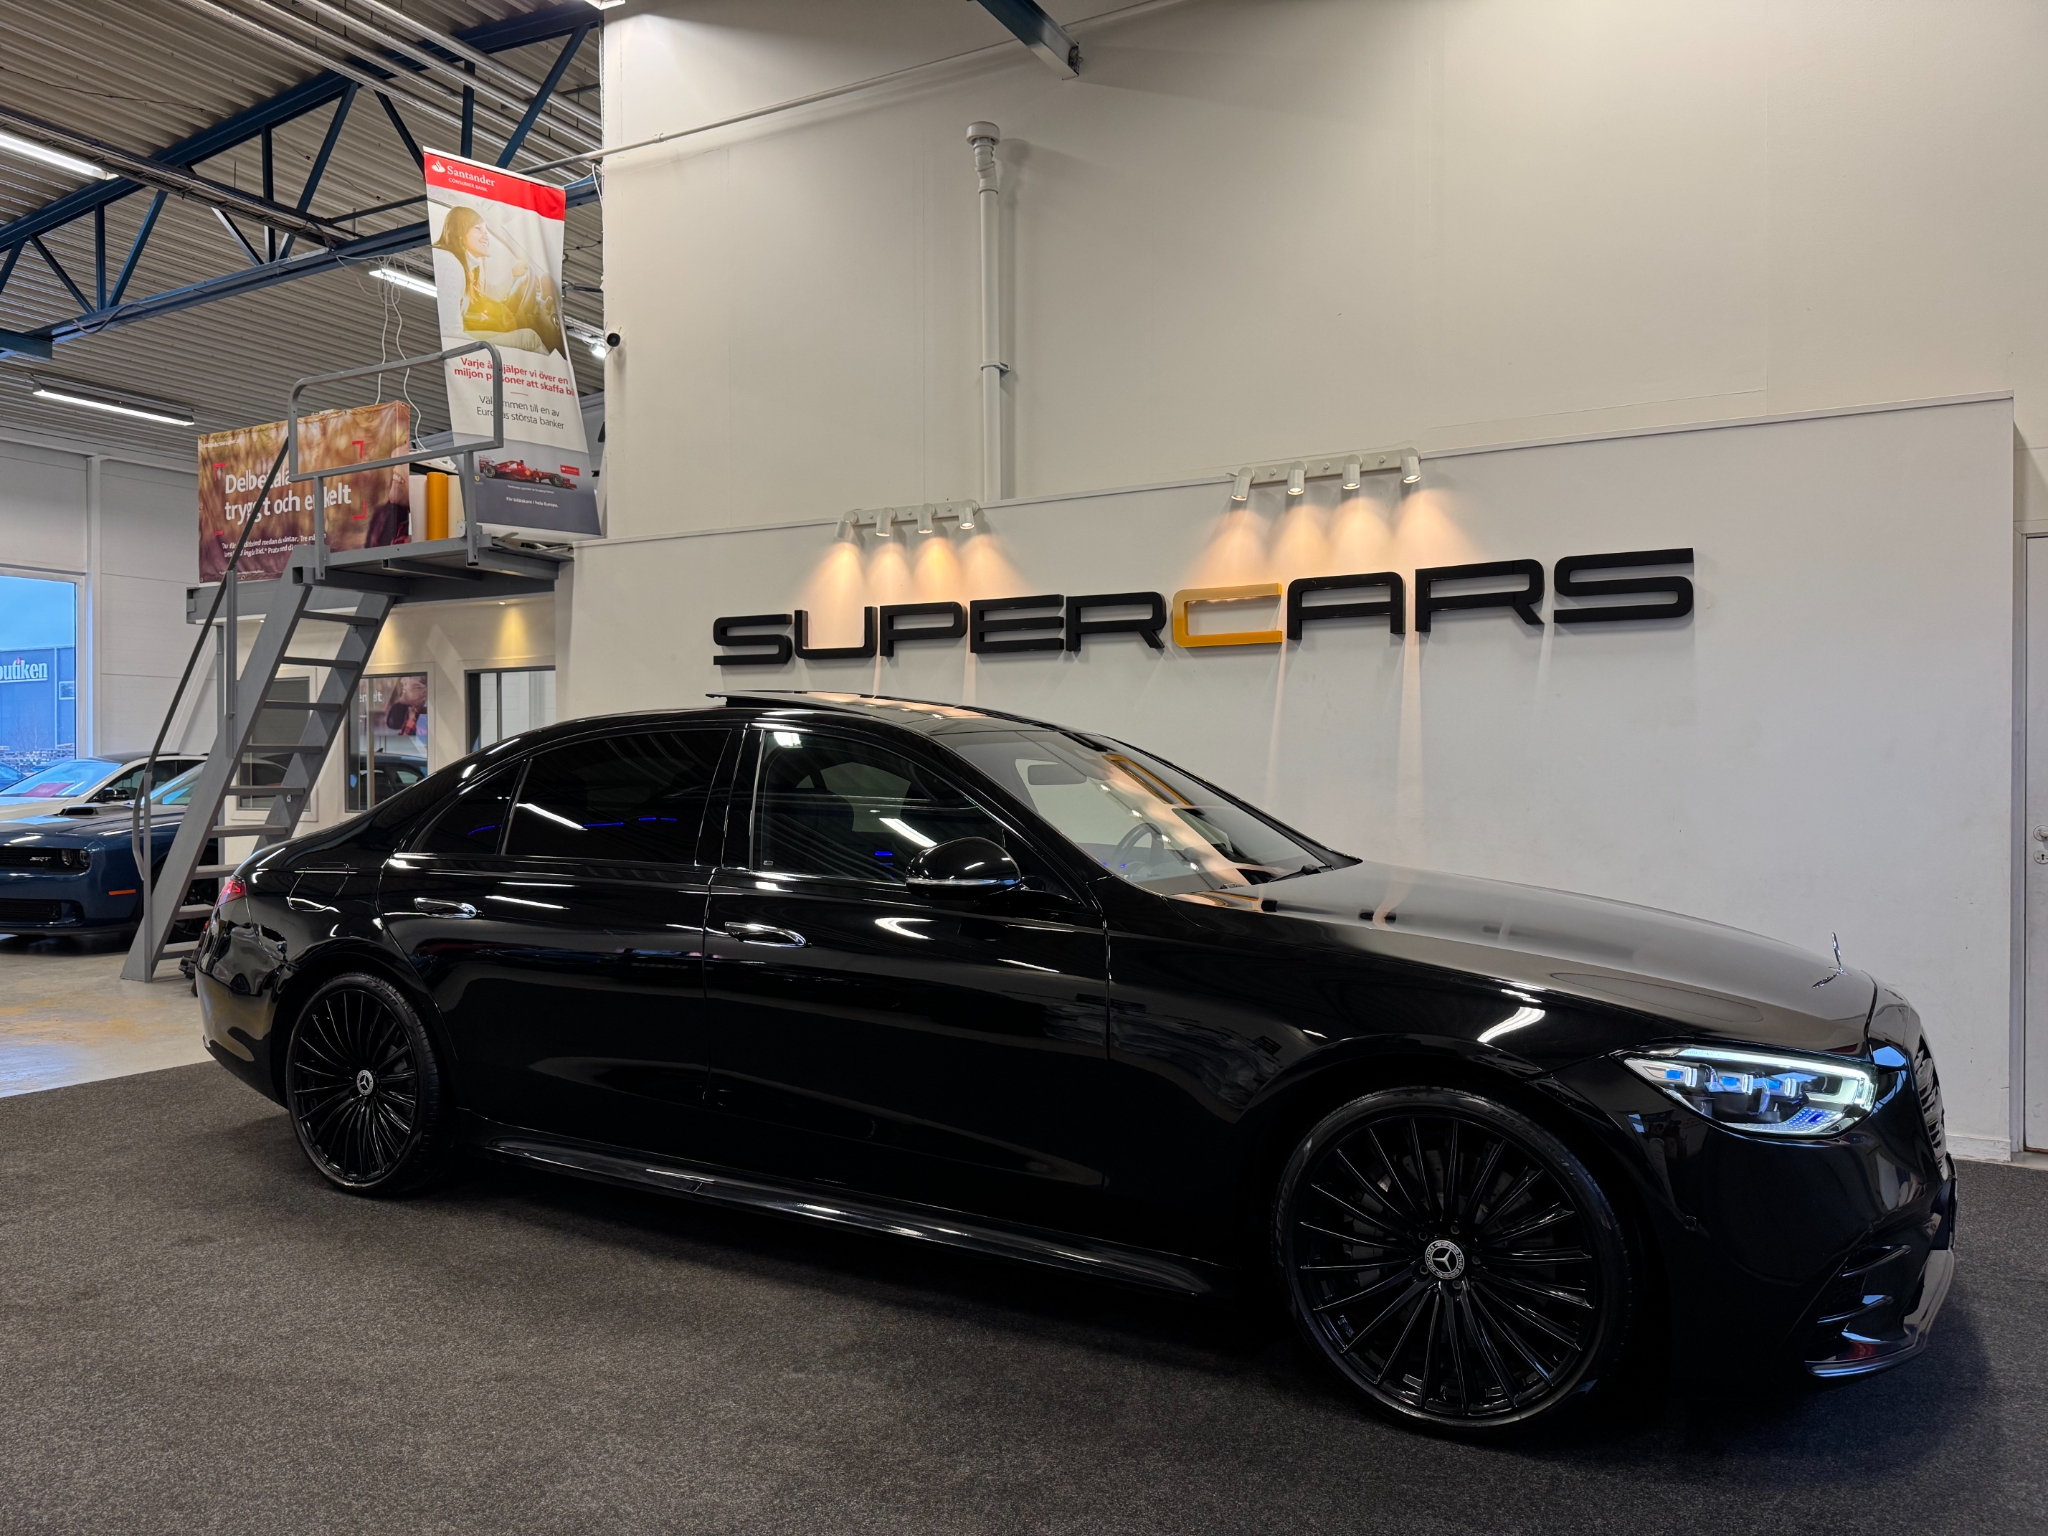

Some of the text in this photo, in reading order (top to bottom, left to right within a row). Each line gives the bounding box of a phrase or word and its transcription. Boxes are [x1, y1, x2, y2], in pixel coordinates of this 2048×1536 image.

[447, 165, 495, 186] Santander
[448, 178, 488, 192] CONSUMER BANK
[454, 368, 575, 396] miljon poner att skaffa bi
[460, 357, 569, 385] Varje å jälper vi över en
[477, 407, 564, 429] Euroas största banker
[478, 395, 528, 410] Välmmen
[529, 403, 539, 413] till
[225, 464, 291, 494] Delbeala
[273, 490, 301, 514] och
[304, 482, 352, 511] ekelt
[713, 548, 1694, 665] SUPERCARS
